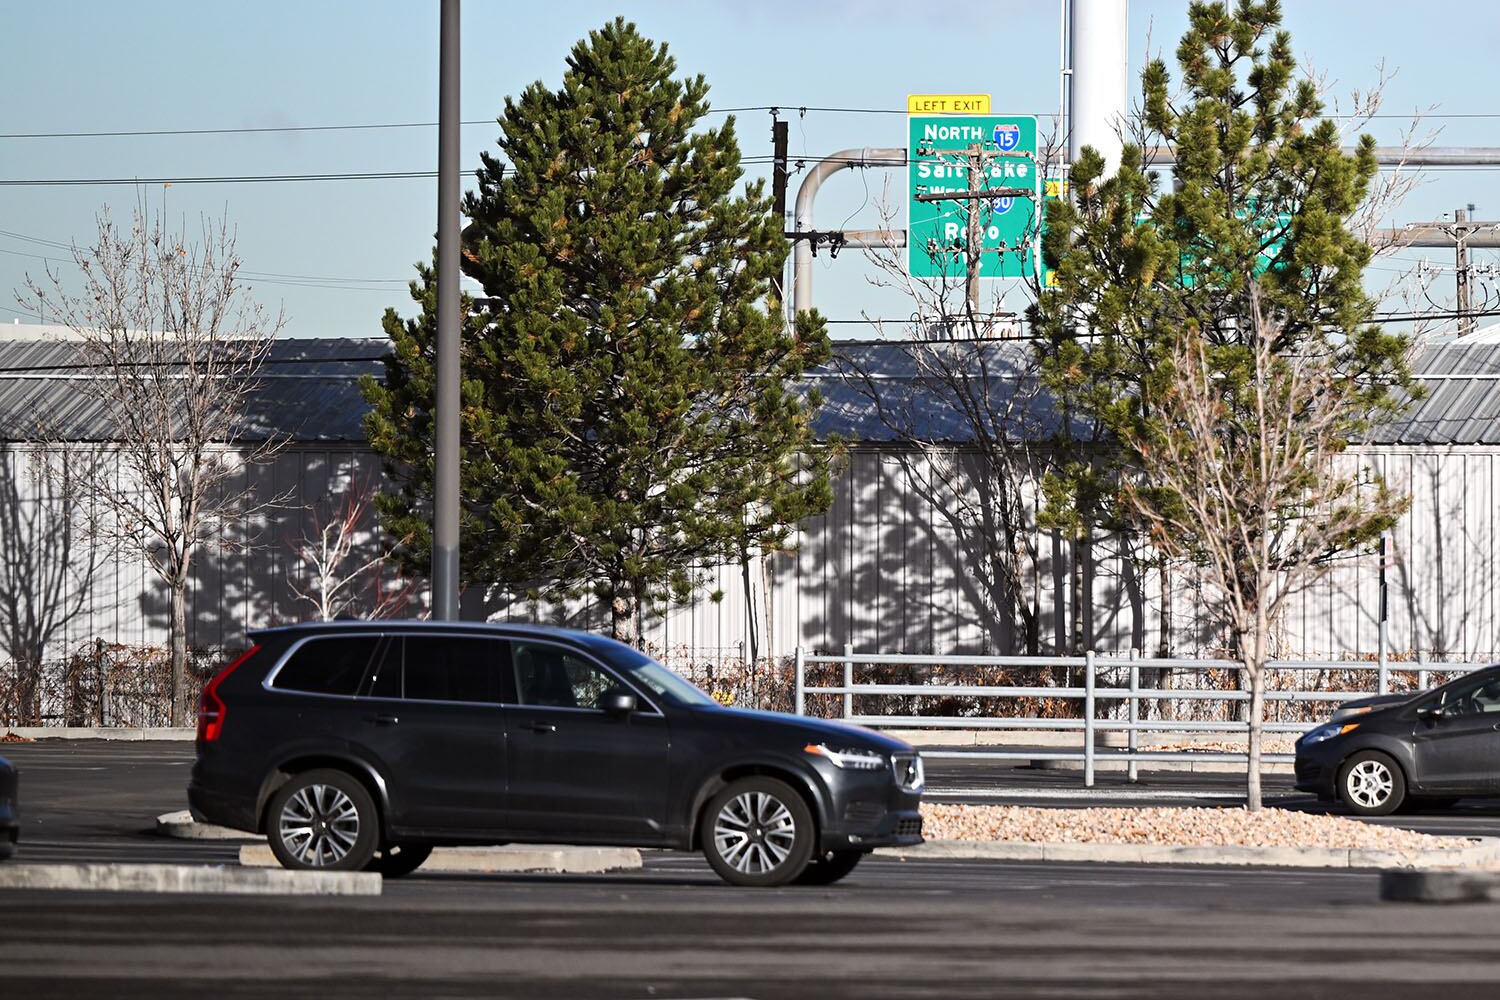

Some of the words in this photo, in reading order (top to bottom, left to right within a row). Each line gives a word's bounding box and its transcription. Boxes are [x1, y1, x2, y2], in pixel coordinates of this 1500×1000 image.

[915, 100, 946, 111] LEFT
[953, 100, 982, 111] EXIT
[924, 124, 983, 140] NORTH
[999, 133, 1014, 147] 15
[918, 161, 964, 179] Salt
